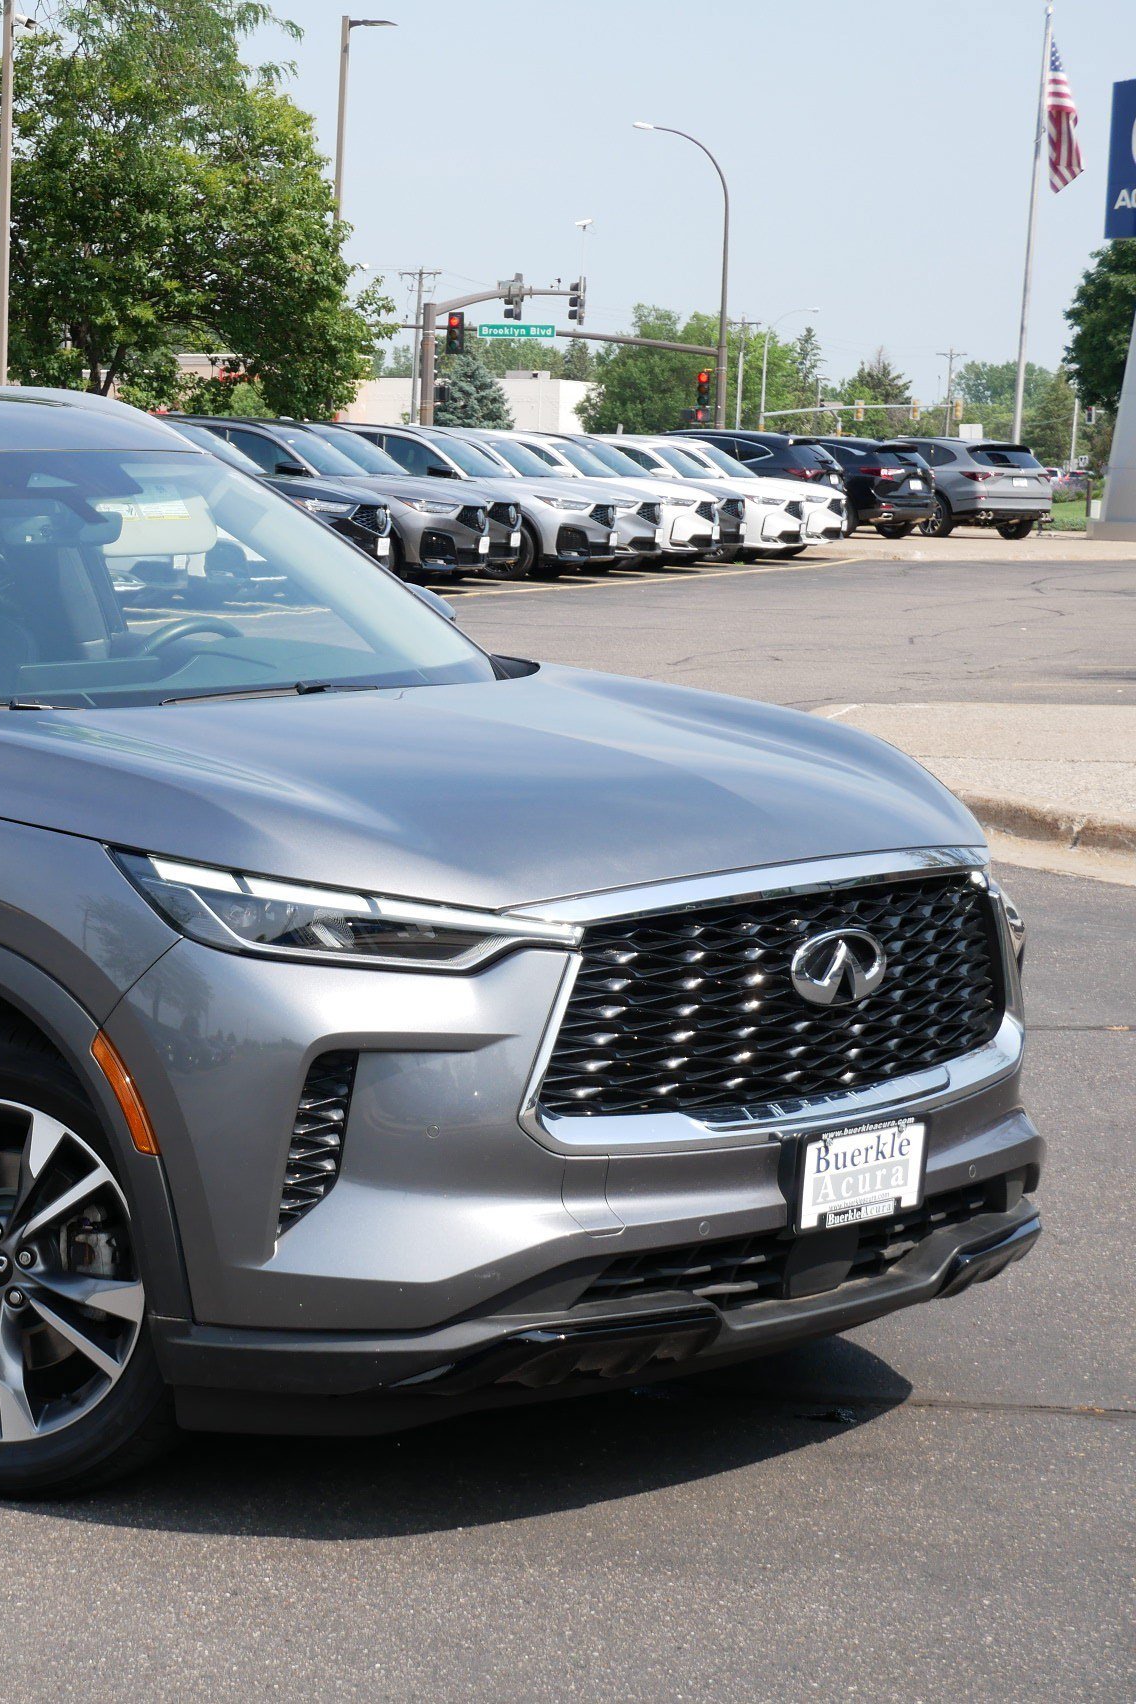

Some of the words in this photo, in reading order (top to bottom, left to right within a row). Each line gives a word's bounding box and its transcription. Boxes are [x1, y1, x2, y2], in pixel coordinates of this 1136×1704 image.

[482, 326, 526, 337] Brooklyn
[530, 327, 552, 336] Blvd
[821, 1116, 915, 1140] www.buerkleacura.com
[815, 1131, 911, 1174] Buerkle
[816, 1165, 905, 1203] Acura
